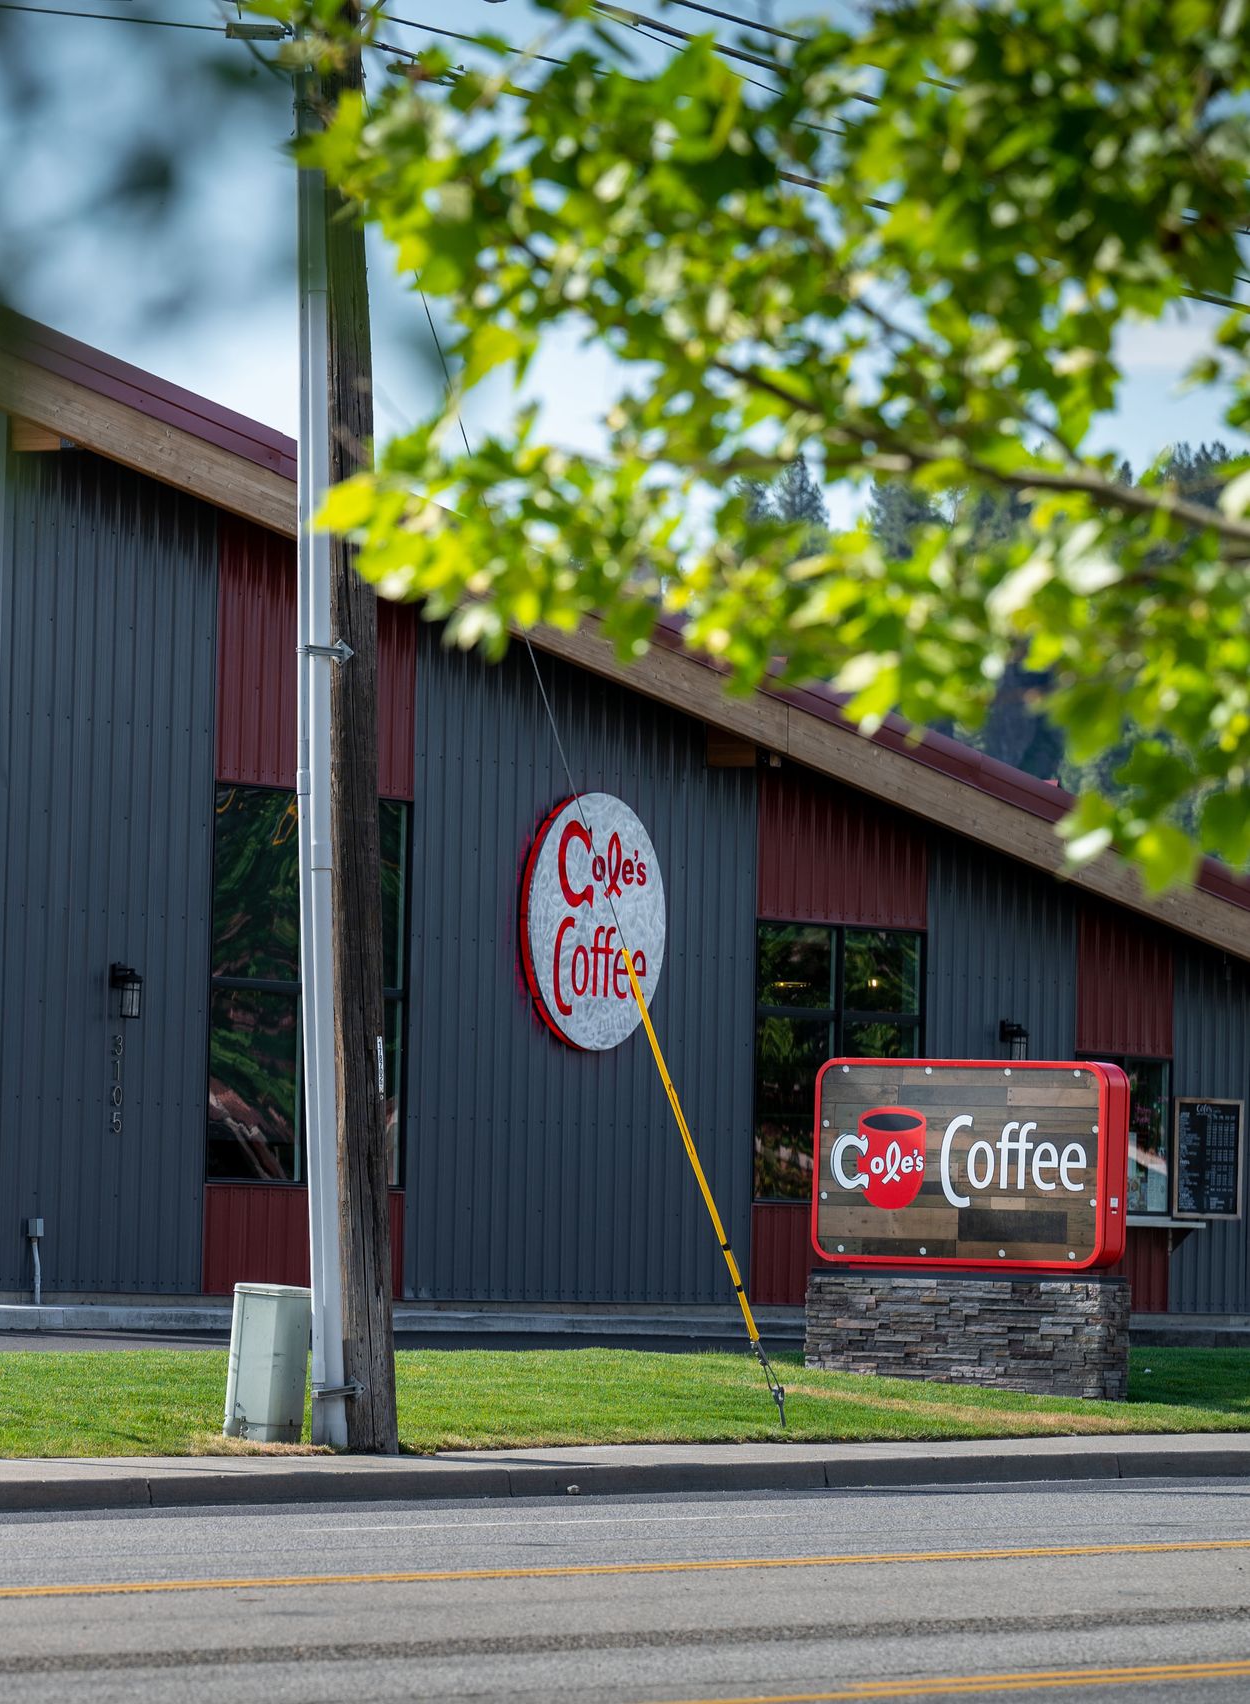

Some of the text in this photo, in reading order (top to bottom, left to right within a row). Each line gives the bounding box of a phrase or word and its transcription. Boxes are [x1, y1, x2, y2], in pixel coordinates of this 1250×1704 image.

[557, 819, 647, 909] Cole's
[552, 915, 647, 1017] Coffee
[112, 1034, 124, 1134] 3105
[829, 1132, 925, 1190] Cole's
[939, 1113, 1088, 1209] Coffee
